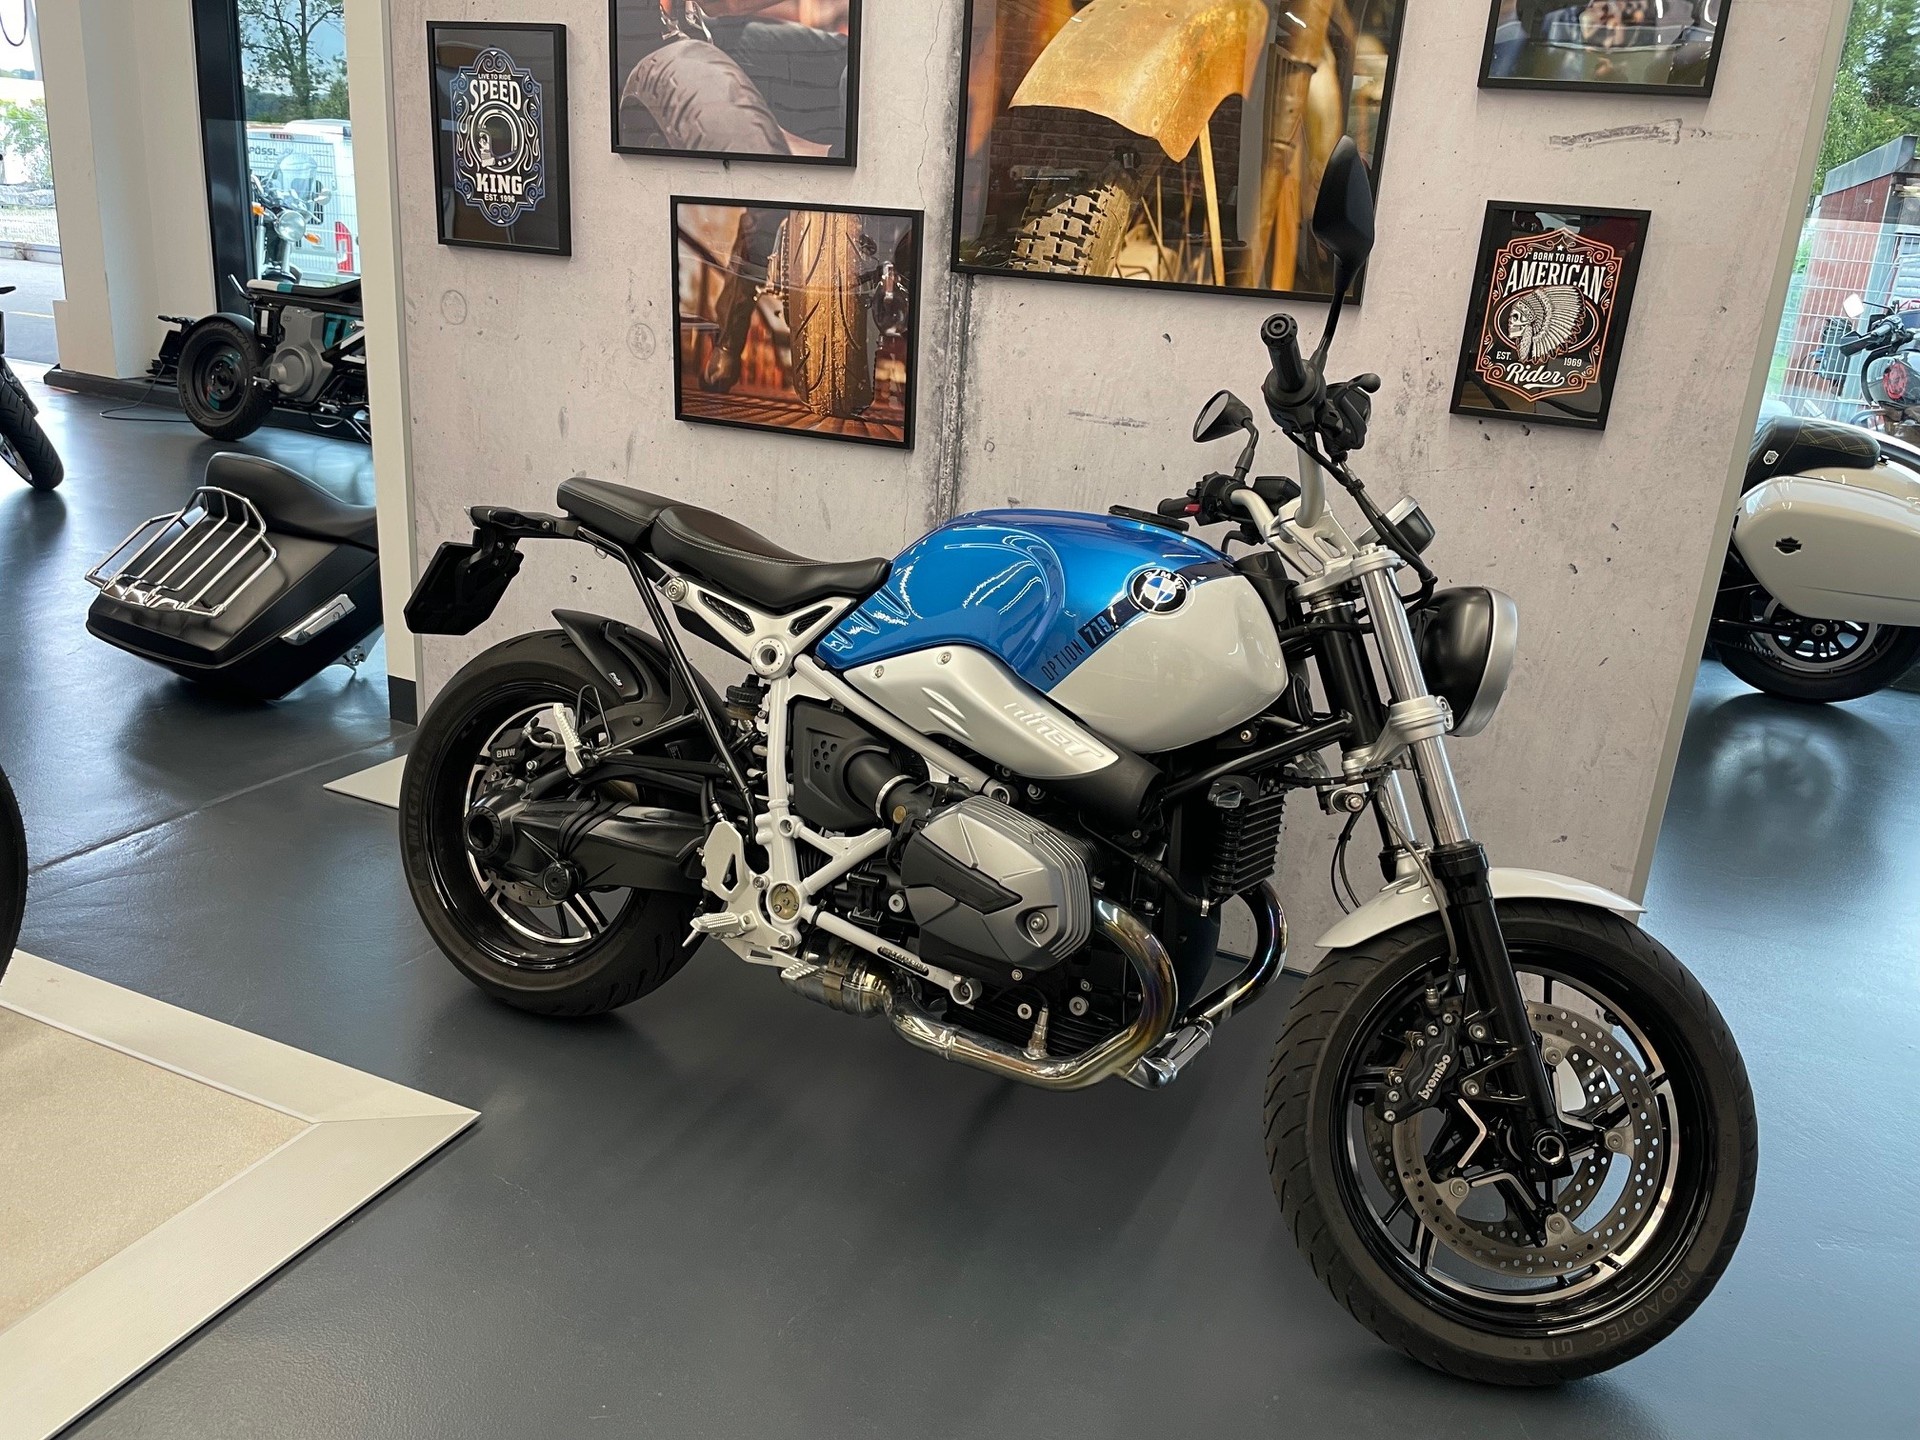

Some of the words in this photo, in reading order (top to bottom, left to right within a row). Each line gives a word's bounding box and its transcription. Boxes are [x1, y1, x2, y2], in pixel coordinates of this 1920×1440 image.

[498, 73, 512, 81] RIDE
[469, 78, 522, 112] SPEED
[476, 173, 523, 195] KING
[484, 193, 499, 203] EST.
[1532, 253, 1553, 263] BORN
[1555, 254, 1565, 263] TO
[1566, 254, 1585, 264] RIDE
[1502, 259, 1606, 305] AMERICAN
[1496, 351, 1512, 361] EST.
[1563, 357, 1582, 367] 1969
[1505, 362, 1565, 390] Rider
[1041, 639, 1086, 681] OPTION
[1084, 615, 1112, 645] 719
[496, 747, 516, 759] BMW
[1417, 1054, 1451, 1100] brembo
[1592, 1268, 1692, 1348] ROADTEC
[1551, 1338, 1574, 1356] 01
